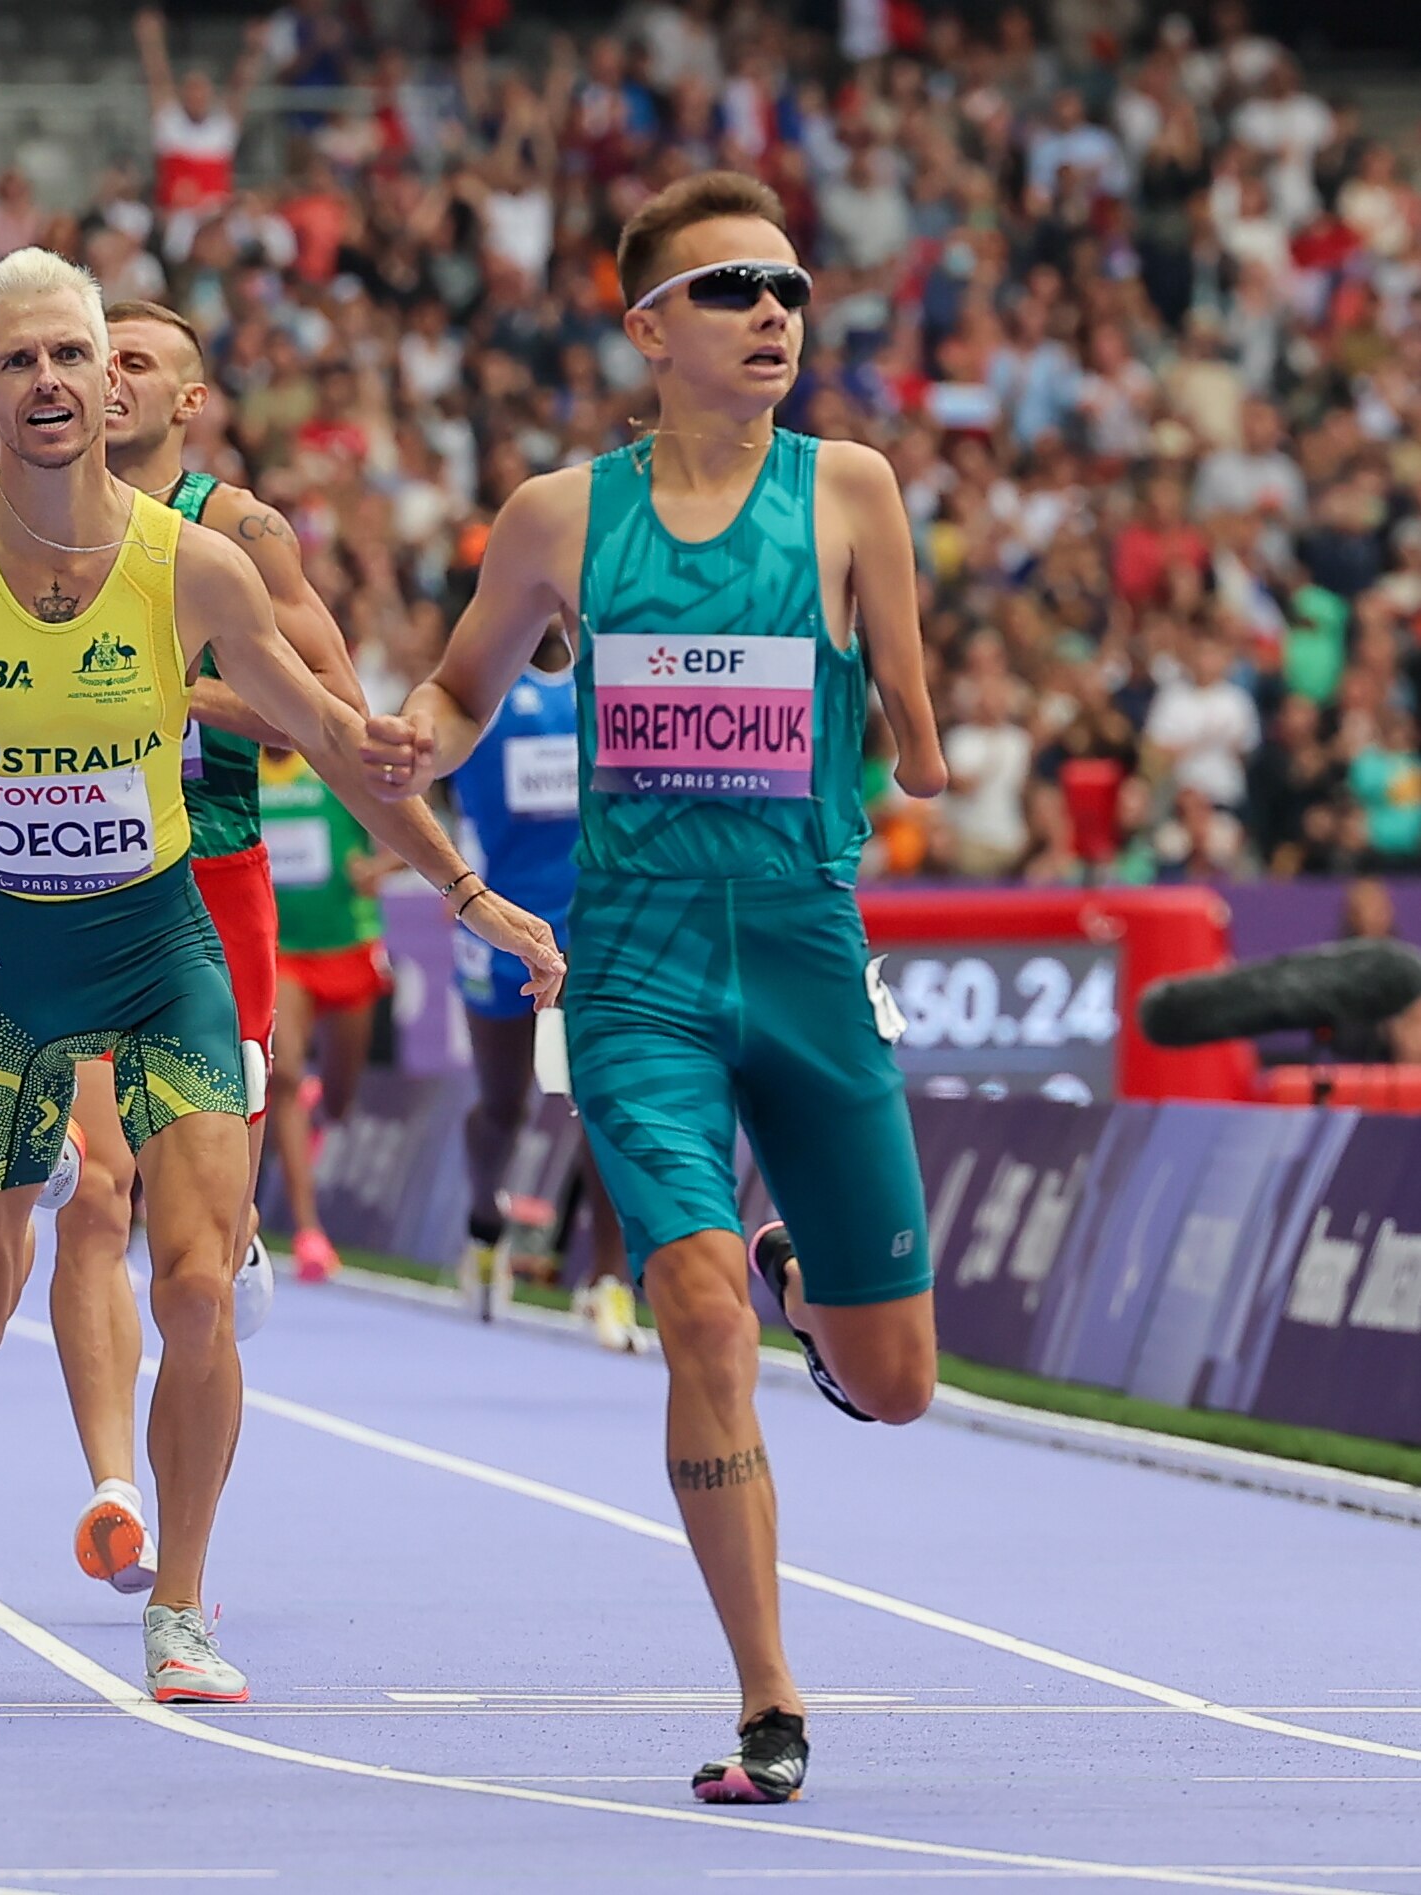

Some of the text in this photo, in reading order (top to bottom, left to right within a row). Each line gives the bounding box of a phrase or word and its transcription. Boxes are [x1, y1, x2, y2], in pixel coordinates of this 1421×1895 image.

[603, 703, 807, 753] IAREMCHUK
[660, 773, 771, 790] PARIS 2024
[22, 879, 117, 891] PARIS 2024
